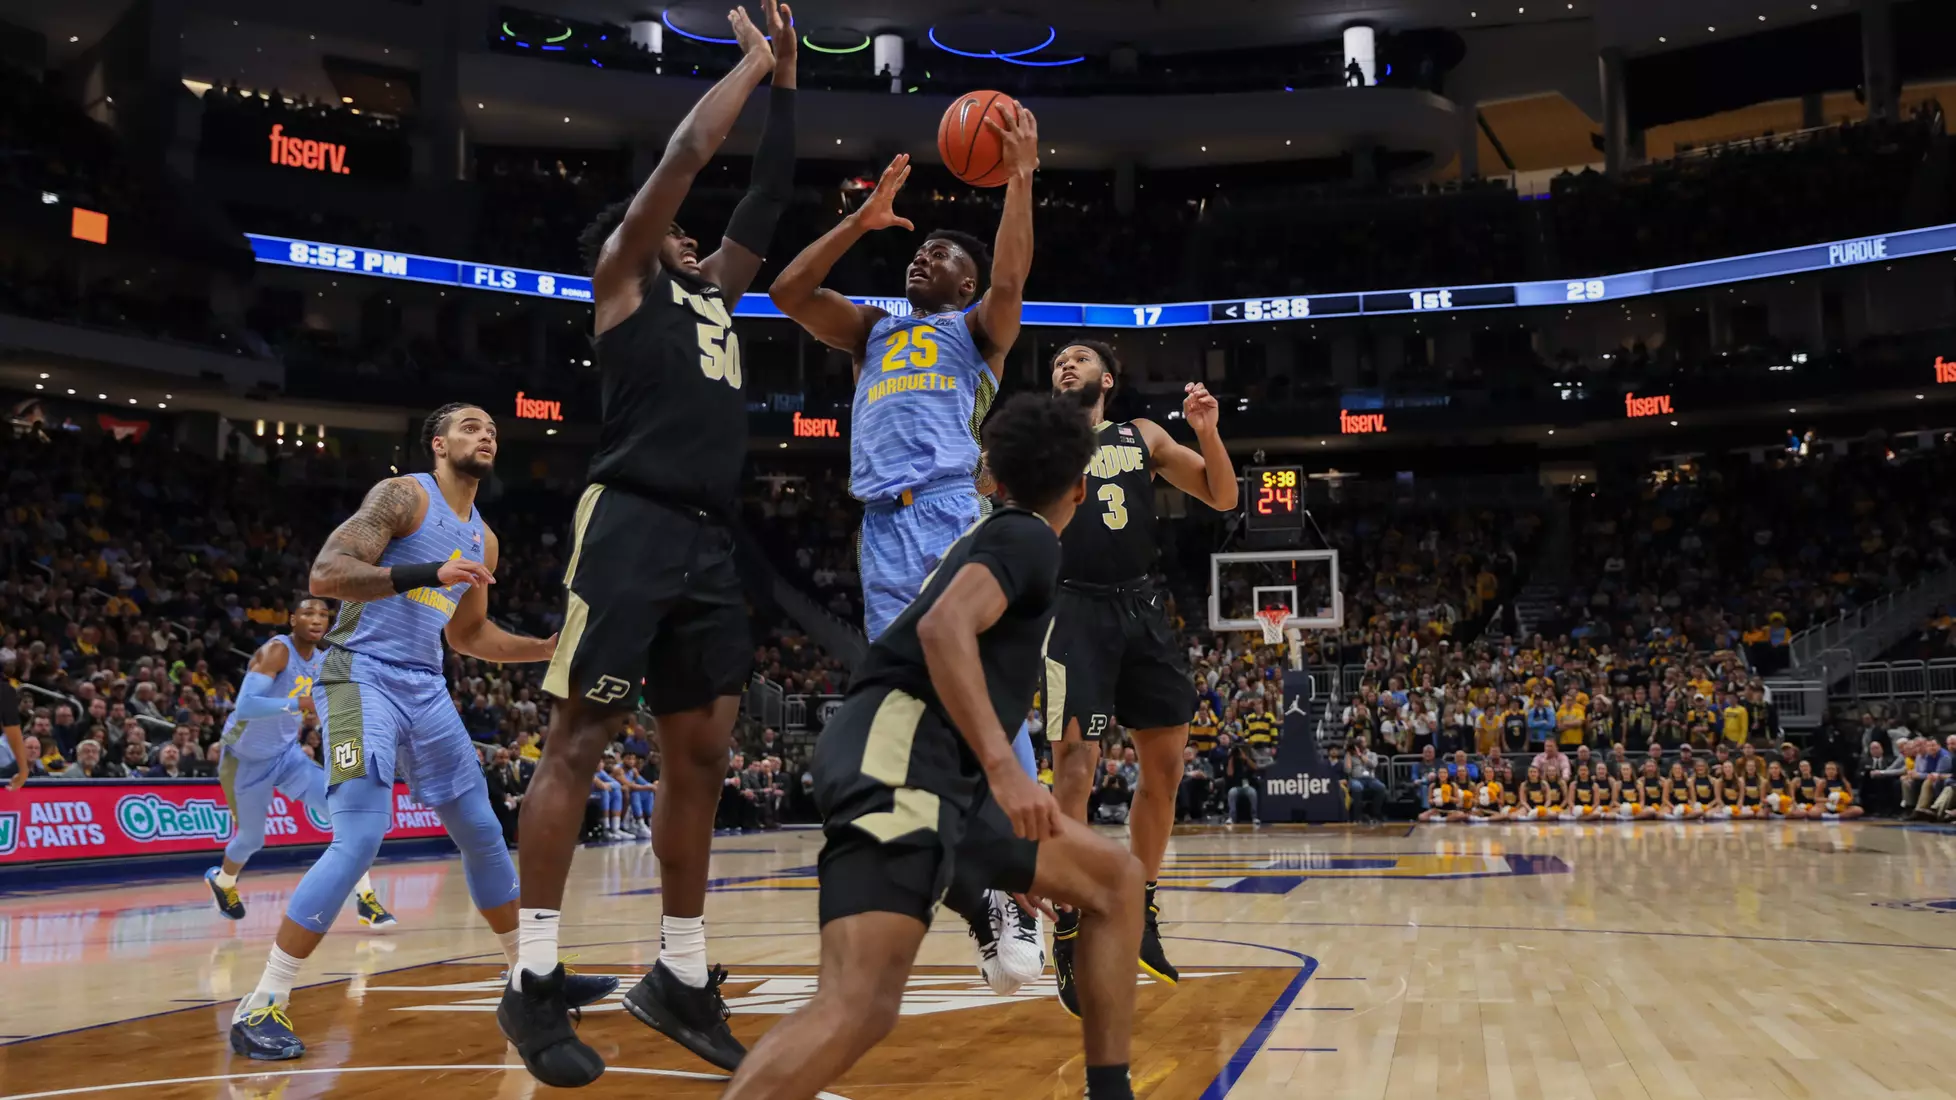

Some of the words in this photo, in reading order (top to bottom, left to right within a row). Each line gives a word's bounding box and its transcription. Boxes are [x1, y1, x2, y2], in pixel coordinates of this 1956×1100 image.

[269, 124, 350, 174] fiserv.
[289, 242, 356, 269] 8:52
[363, 252, 408, 276] PM
[1829, 238, 1887, 265] PURDUE
[474, 267, 517, 289] FLS
[537, 275, 555, 295] 8
[1566, 280, 1605, 300] 29
[1244, 298, 1310, 321] 5:38
[1410, 290, 1453, 310] 1st
[1133, 307, 1163, 326] 17
[697, 322, 742, 390] 50
[881, 325, 938, 373] 25
[868, 373, 957, 404] MARQUETTE
[515, 391, 563, 421] fiserv.
[1625, 392, 1674, 417] fiserv.
[793, 411, 840, 437] fiserv.
[1340, 409, 1387, 433] fiserv.
[1262, 471, 1296, 488] 5:38
[1097, 483, 1128, 530] 3
[1258, 488, 1292, 514] 24
[585, 675, 630, 704] P
[1087, 714, 1107, 736] P
[333, 740, 359, 770] MU
[1267, 773, 1331, 799] meijer
[31, 801, 93, 825] AUTO
[120, 797, 231, 839] O'Reilly
[396, 810, 441, 829] PARTS
[26, 824, 106, 848] PARTS
